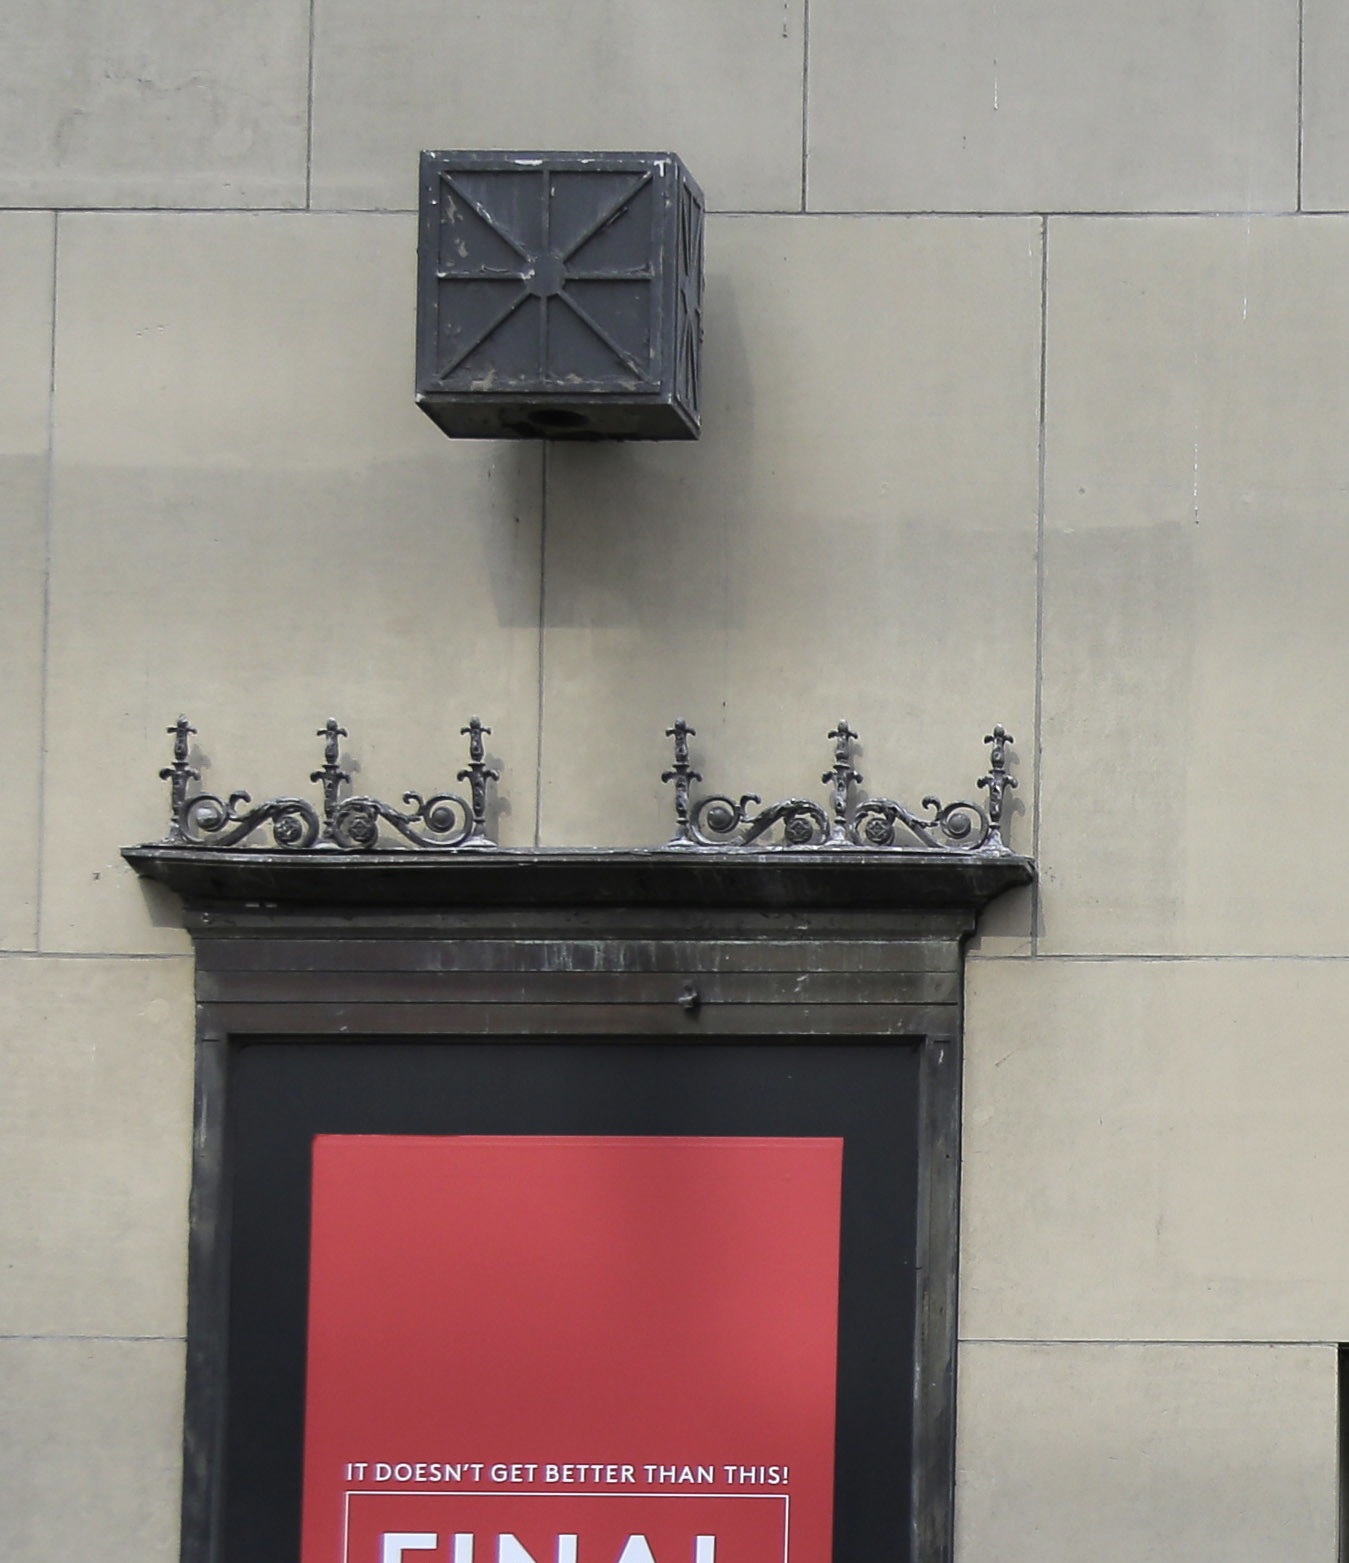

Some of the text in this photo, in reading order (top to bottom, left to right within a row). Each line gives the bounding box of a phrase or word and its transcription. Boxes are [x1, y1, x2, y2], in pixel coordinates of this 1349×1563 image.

[345, 1462, 790, 1486] IT DOESN'T GET BETTER THAN THIS!
